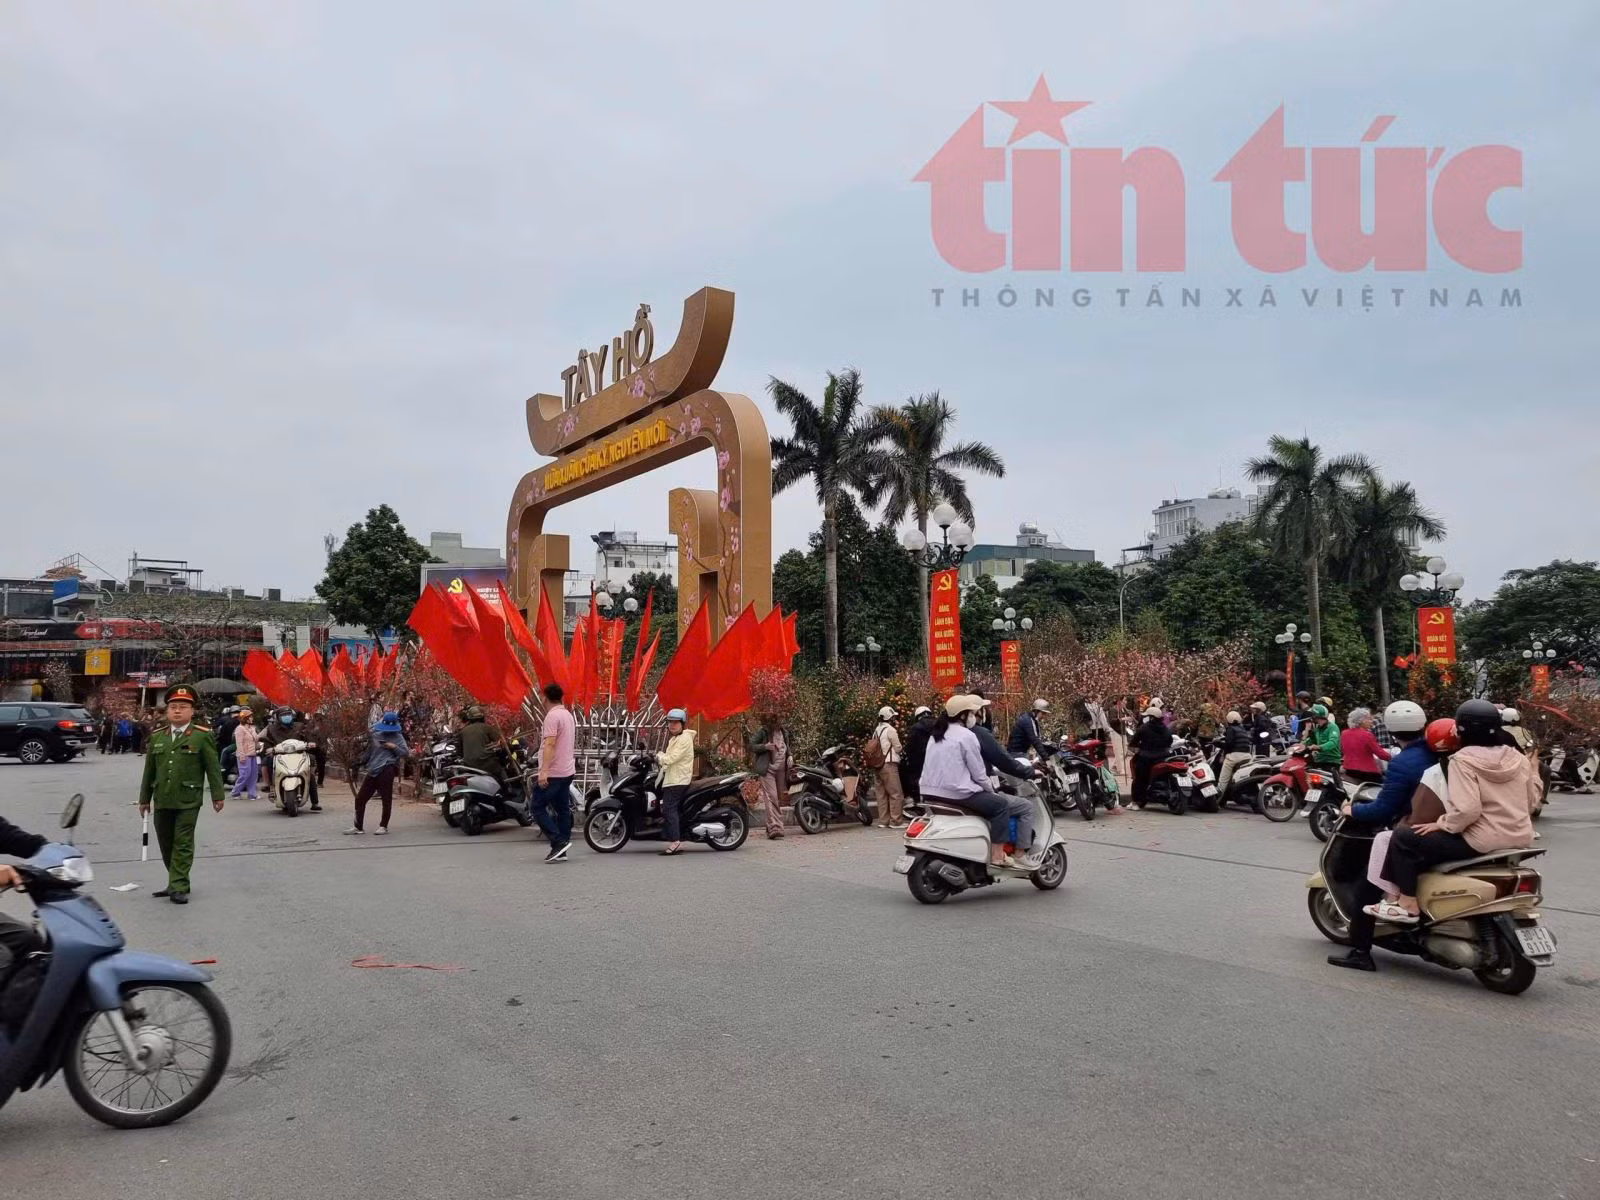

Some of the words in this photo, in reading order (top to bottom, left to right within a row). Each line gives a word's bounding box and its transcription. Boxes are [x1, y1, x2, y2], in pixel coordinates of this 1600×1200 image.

[561, 345, 609, 410] TÂY
[612, 303, 654, 384] HỒ
[1526, 940, 1552, 954] 9116
